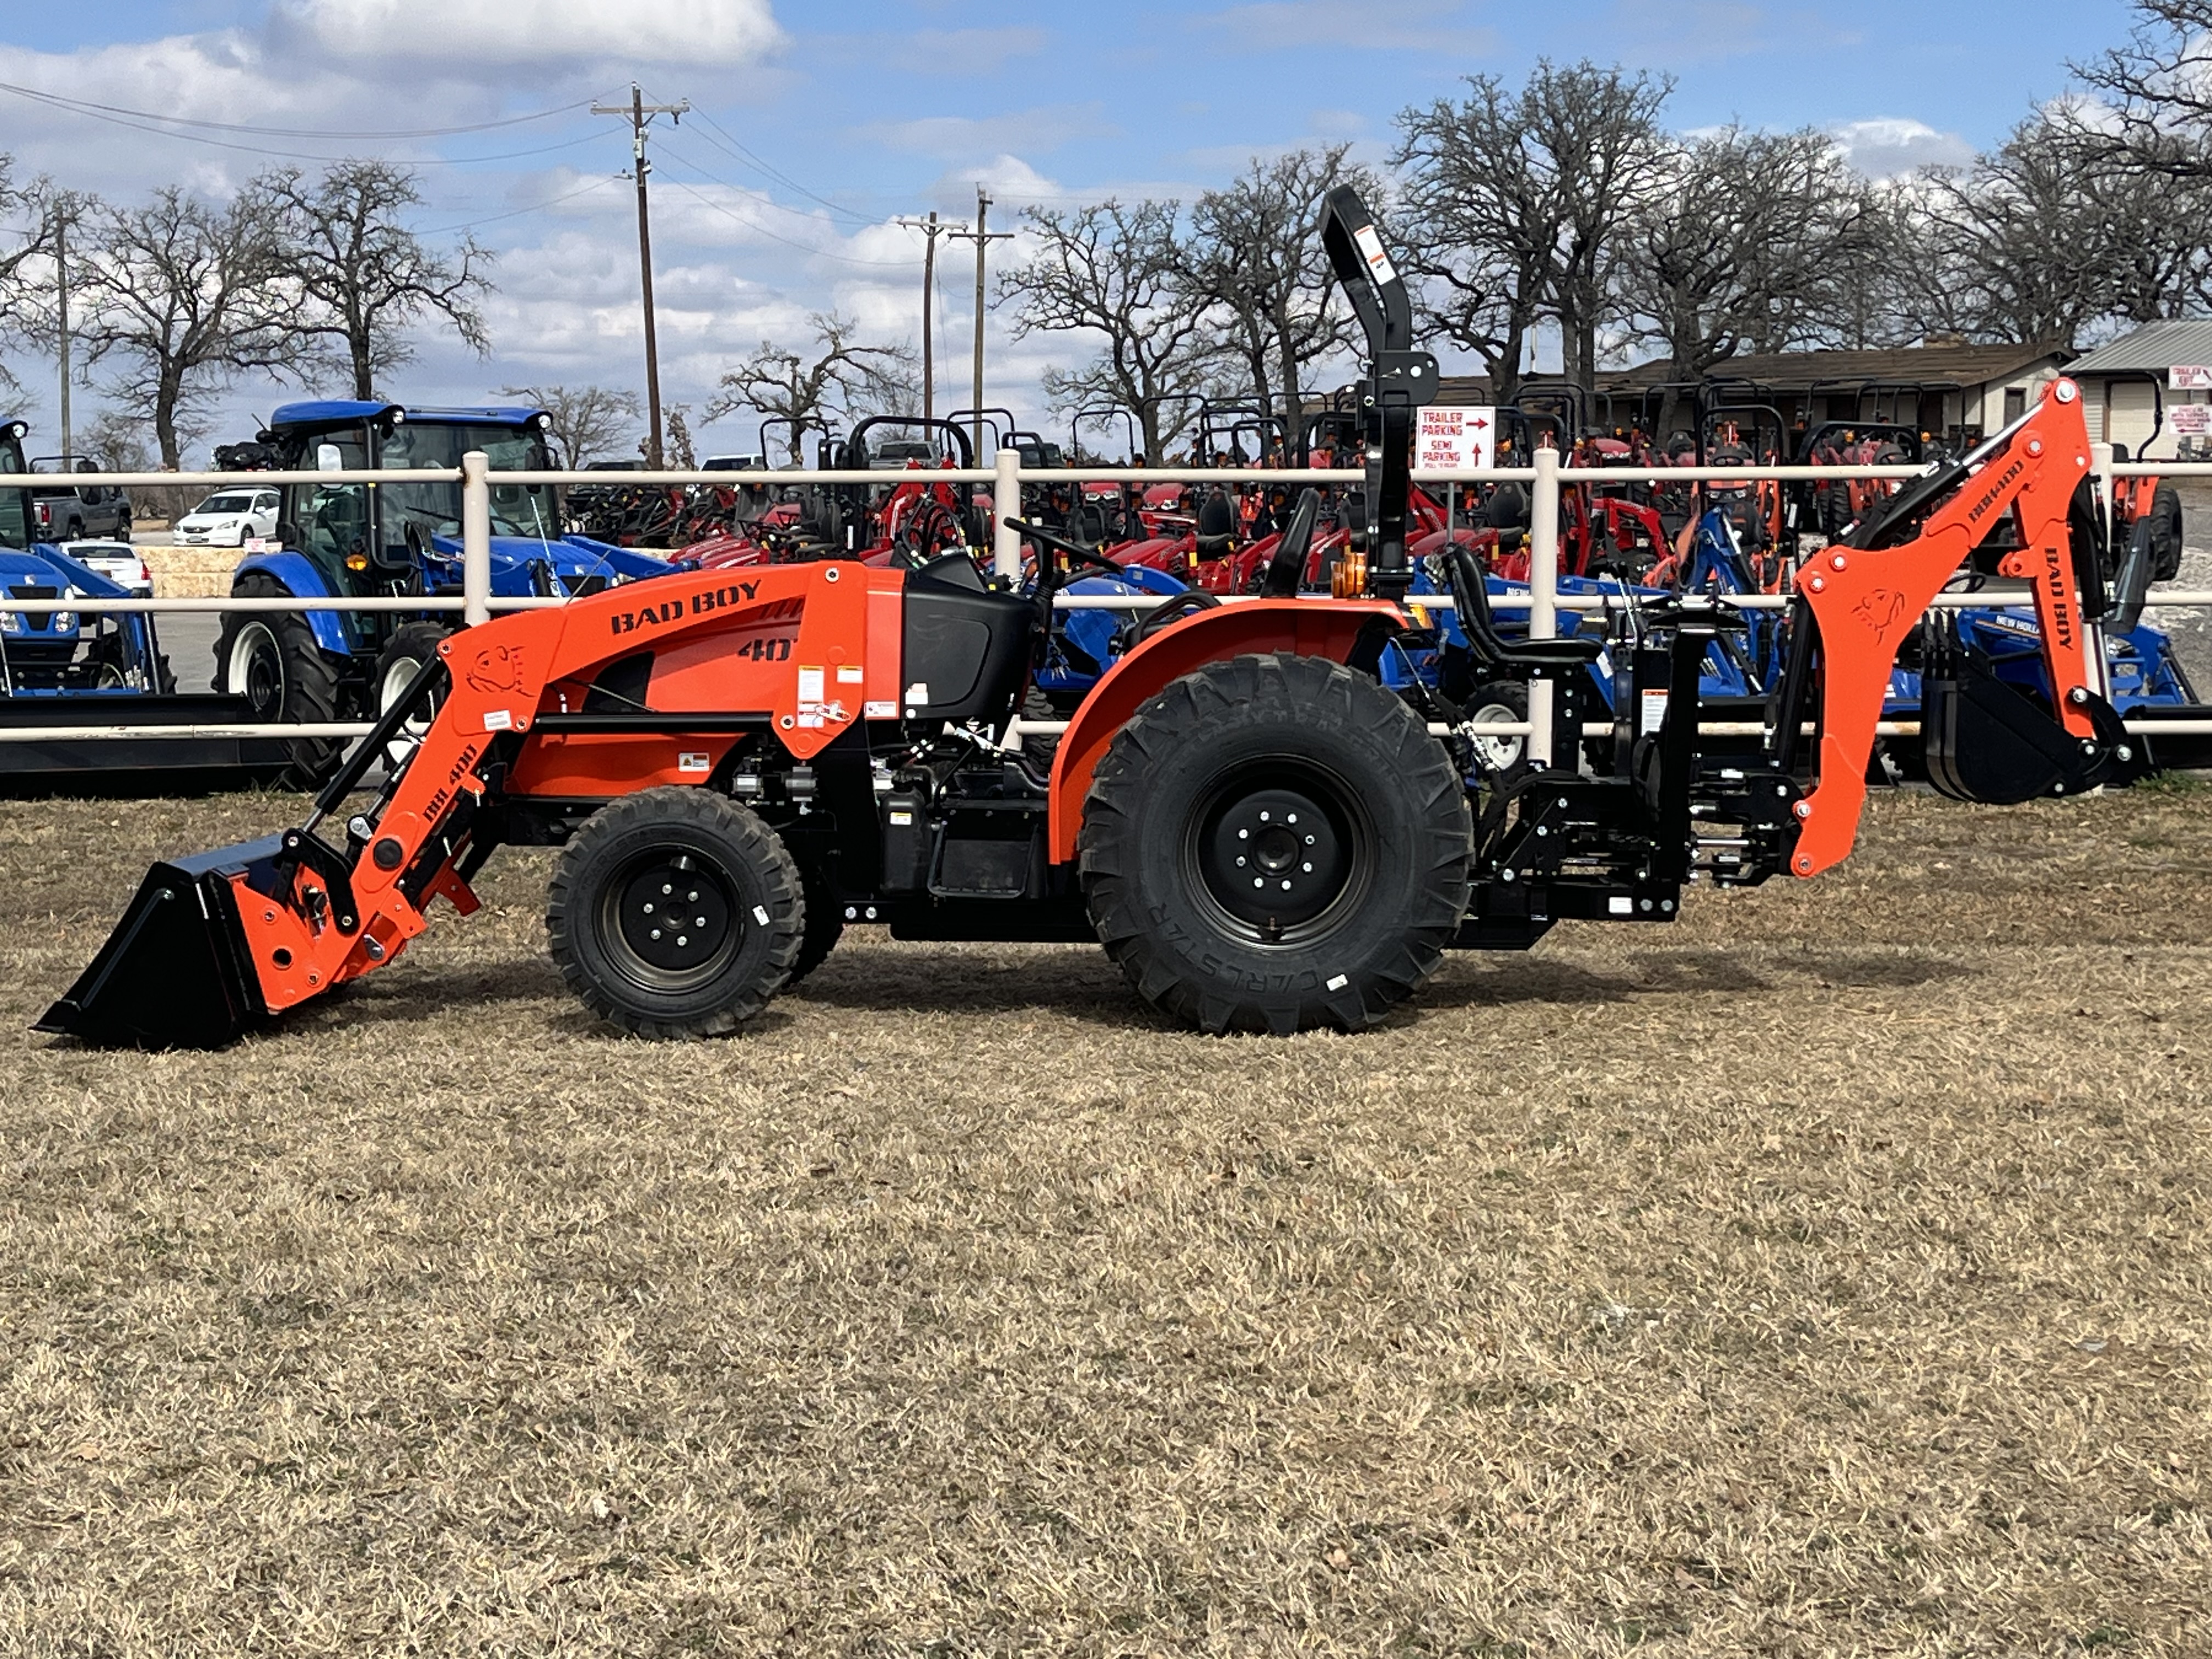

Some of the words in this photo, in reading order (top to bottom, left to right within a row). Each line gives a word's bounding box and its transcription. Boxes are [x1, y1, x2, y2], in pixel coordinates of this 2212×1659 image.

[1422, 425, 1463, 436] PARKING
[1423, 412, 1463, 423] TRAILER
[1423, 452, 1461, 462] PARKING
[2045, 548, 2064, 597] BAD
[611, 600, 684, 635] BAD
[691, 579, 761, 614] BOY
[1996, 615, 2017, 628] NEW
[2053, 603, 2074, 651] BOY
[738, 638, 798, 662] 40
[449, 743, 477, 786] 400
[1147, 902, 1319, 994] CARLSTAR
